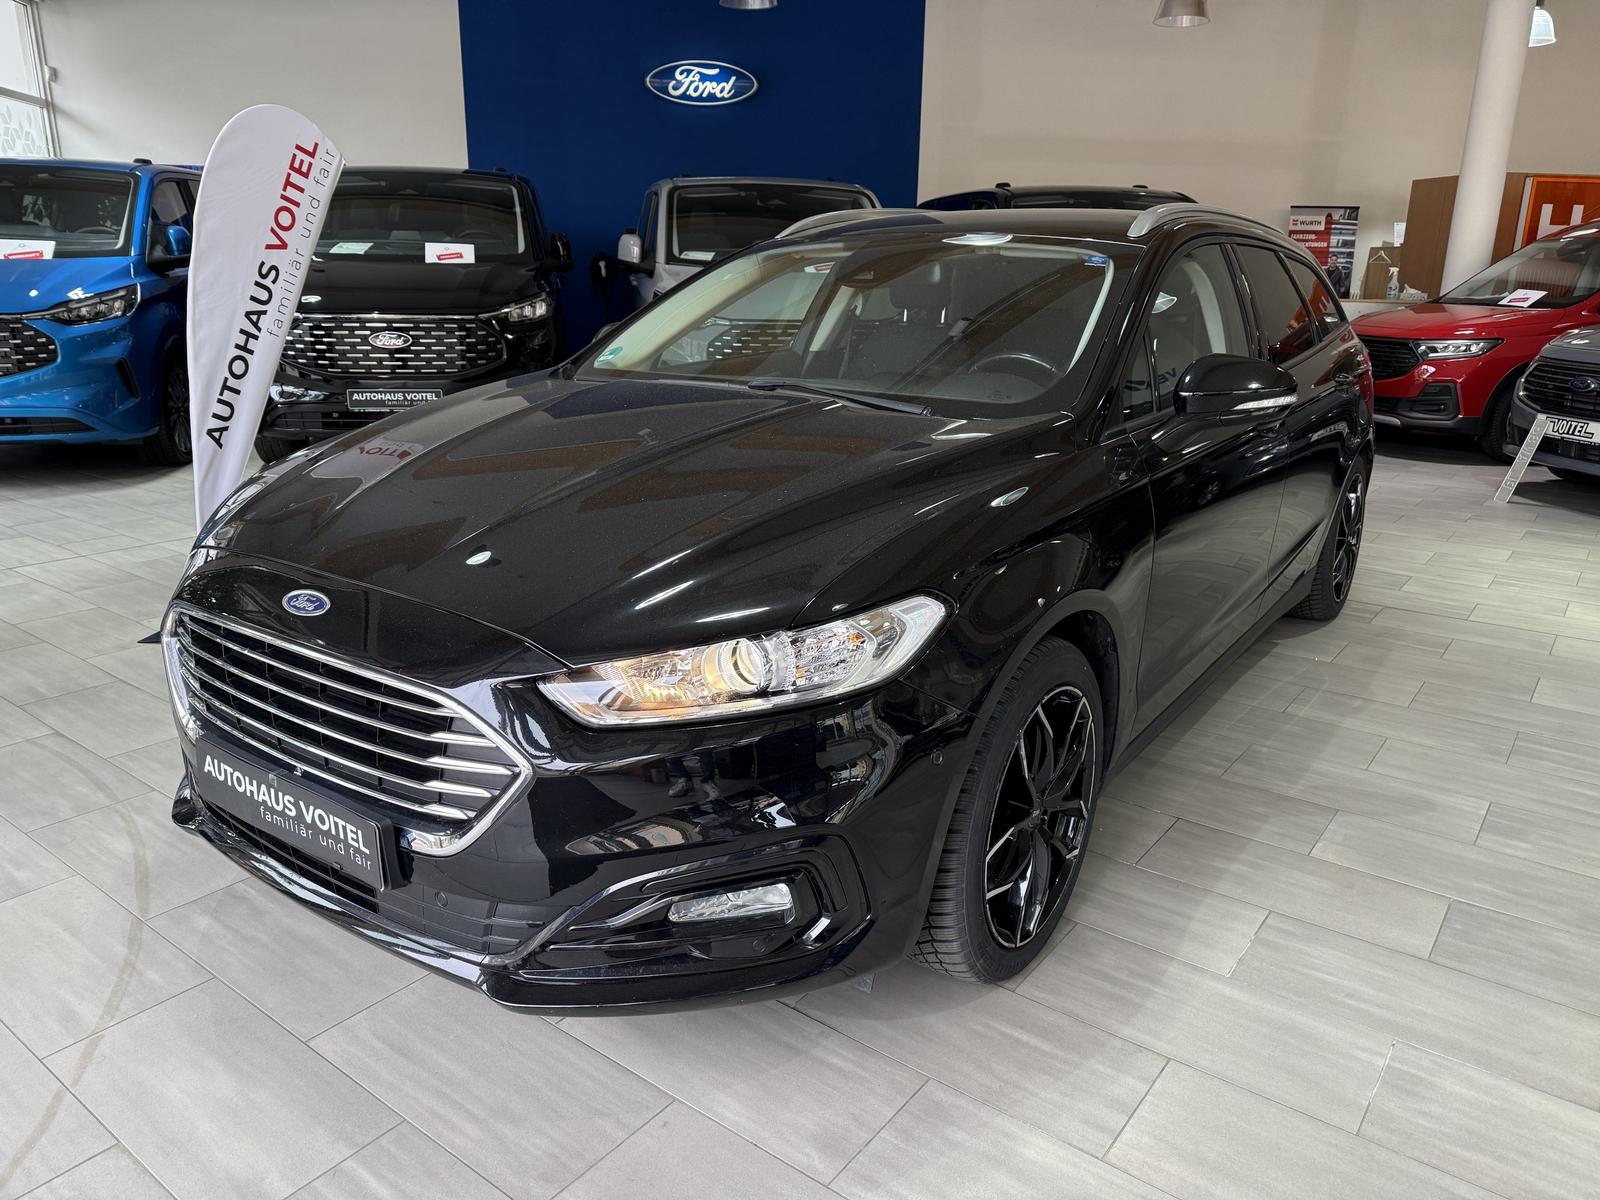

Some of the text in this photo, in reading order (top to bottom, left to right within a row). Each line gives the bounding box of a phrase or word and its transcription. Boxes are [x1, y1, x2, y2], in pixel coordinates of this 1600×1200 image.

[668, 65, 736, 98] Ford
[267, 148, 337, 338] familiär und fair
[206, 142, 319, 449] AUTOHAUS VOITEL
[376, 333, 405, 346] Ford
[1545, 416, 1595, 438] VOITEL
[290, 594, 320, 611] Ford
[204, 755, 370, 854] AUTOHAUS VOITEL
[260, 806, 371, 871] familiär und fair
